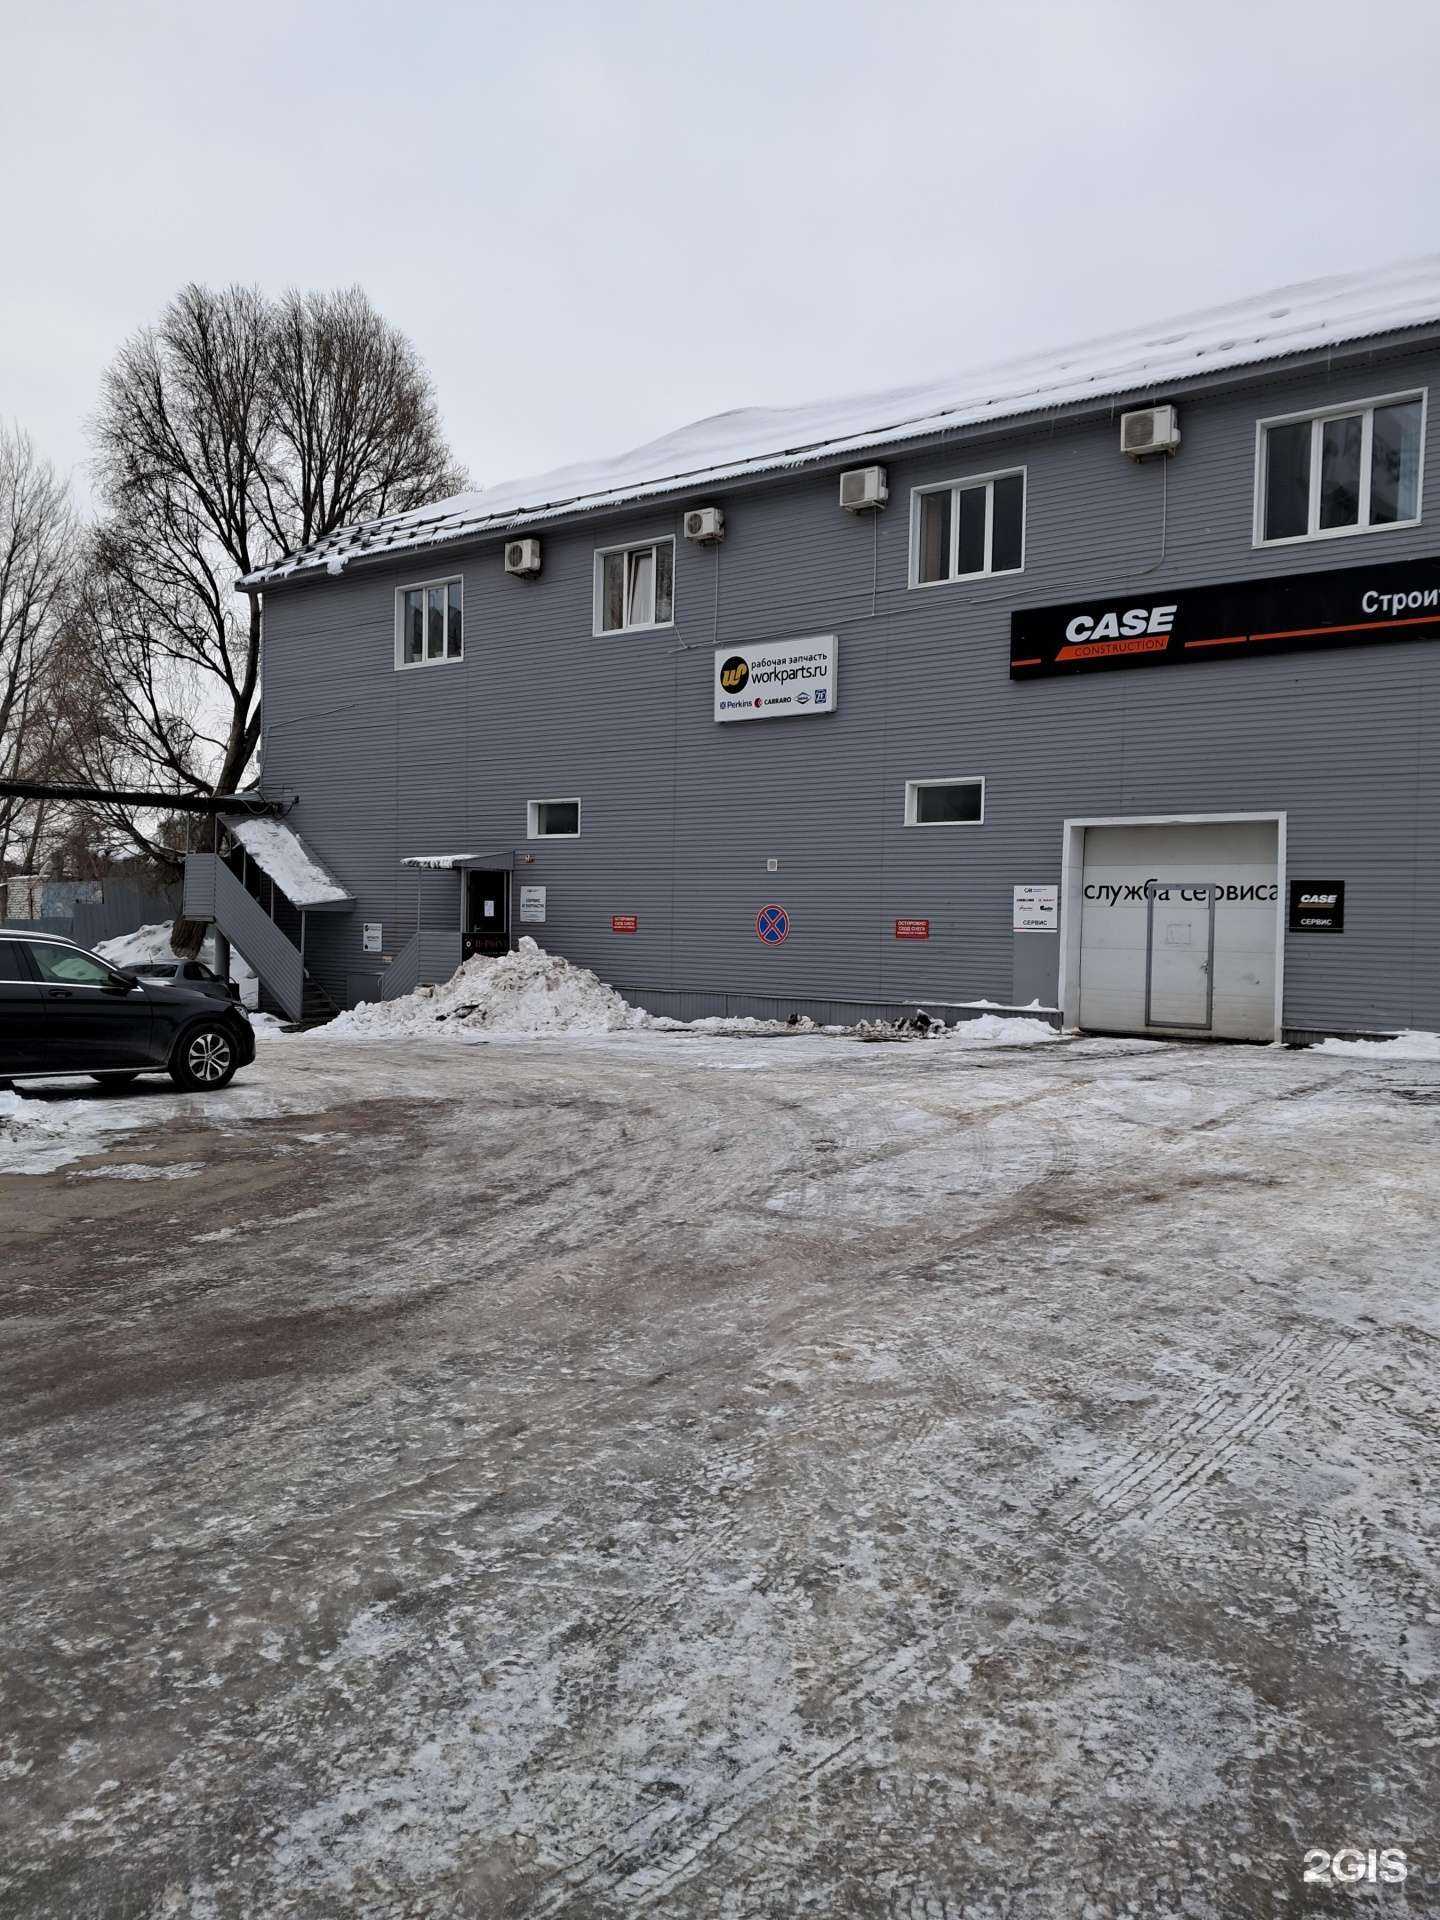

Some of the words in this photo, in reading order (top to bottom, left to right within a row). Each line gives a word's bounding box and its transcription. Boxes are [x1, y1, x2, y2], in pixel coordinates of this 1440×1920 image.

[1361, 589, 1440, 616] Строи
[1065, 605, 1178, 643] CASE
[1074, 639, 1164, 657] CONSTRUCTION
[751, 657, 787, 671] рабочая
[788, 653, 828, 665] запчасть
[751, 665, 828, 686] workparts.ru
[727, 699, 752, 709] Perkins
[764, 696, 792, 706] CARRARO
[1300, 894, 1338, 903] CASE
[1300, 918, 1332, 926] СЕРВИС
